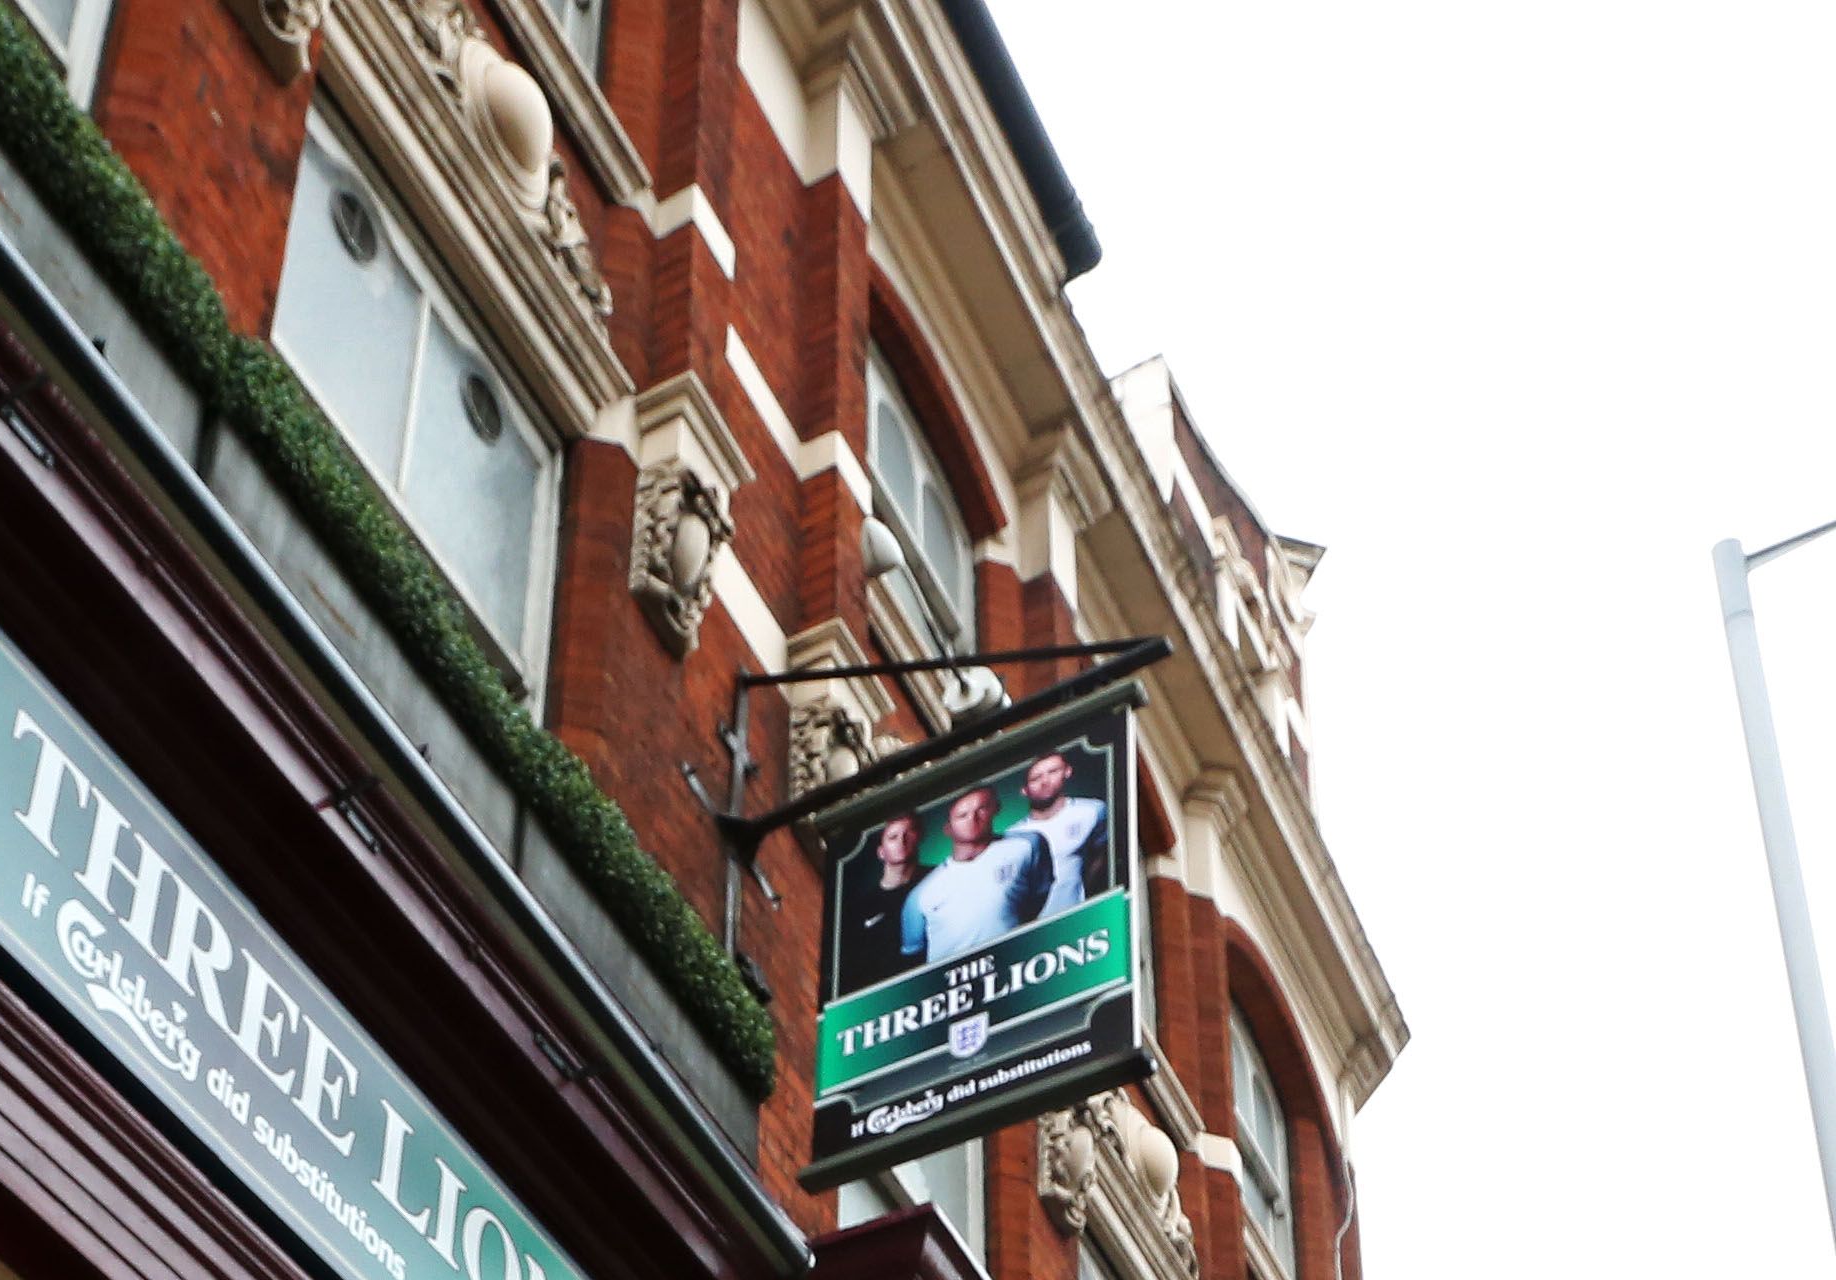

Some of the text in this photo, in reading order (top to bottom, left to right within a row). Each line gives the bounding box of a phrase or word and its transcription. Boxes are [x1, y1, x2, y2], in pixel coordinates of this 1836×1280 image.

[13, 714, 359, 1157] THREE
[836, 928, 1111, 1057] THREE LIONS
[944, 954, 995, 987] THE
[21, 873, 406, 1280] If Carlsberg did substitutions
[866, 1089, 944, 1134] Carlsberg
[946, 1079, 977, 1103] did
[978, 1040, 1092, 1092] substitutions
